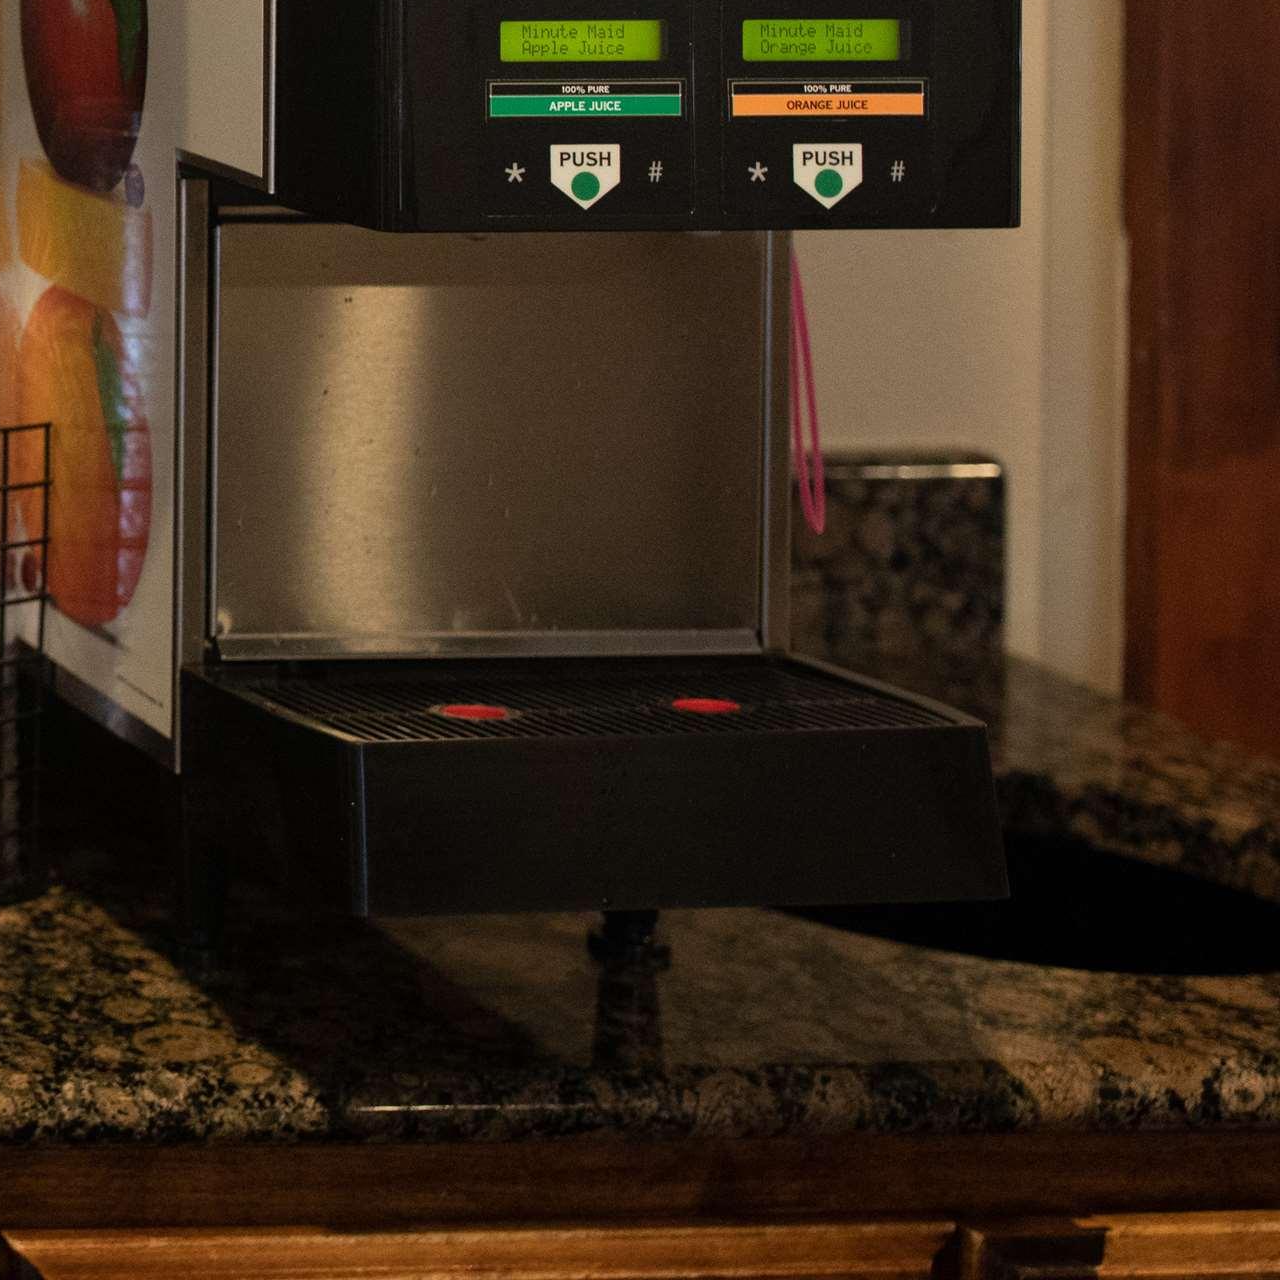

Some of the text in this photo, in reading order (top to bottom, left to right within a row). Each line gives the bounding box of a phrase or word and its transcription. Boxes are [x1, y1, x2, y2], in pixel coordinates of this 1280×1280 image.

[521, 23, 625, 39] Minute Maid
[760, 23, 863, 38] Minute Maid
[521, 40, 625, 56] Apple Juice
[760, 39, 873, 56] Orange Juice
[561, 85, 610, 95] 100% PURE
[803, 84, 852, 94] 100% PURE
[548, 100, 622, 112] APPLE JUICE
[786, 99, 869, 111] ORANGE JUICE
[559, 151, 613, 169] PUSH
[802, 150, 855, 168] PUSH
